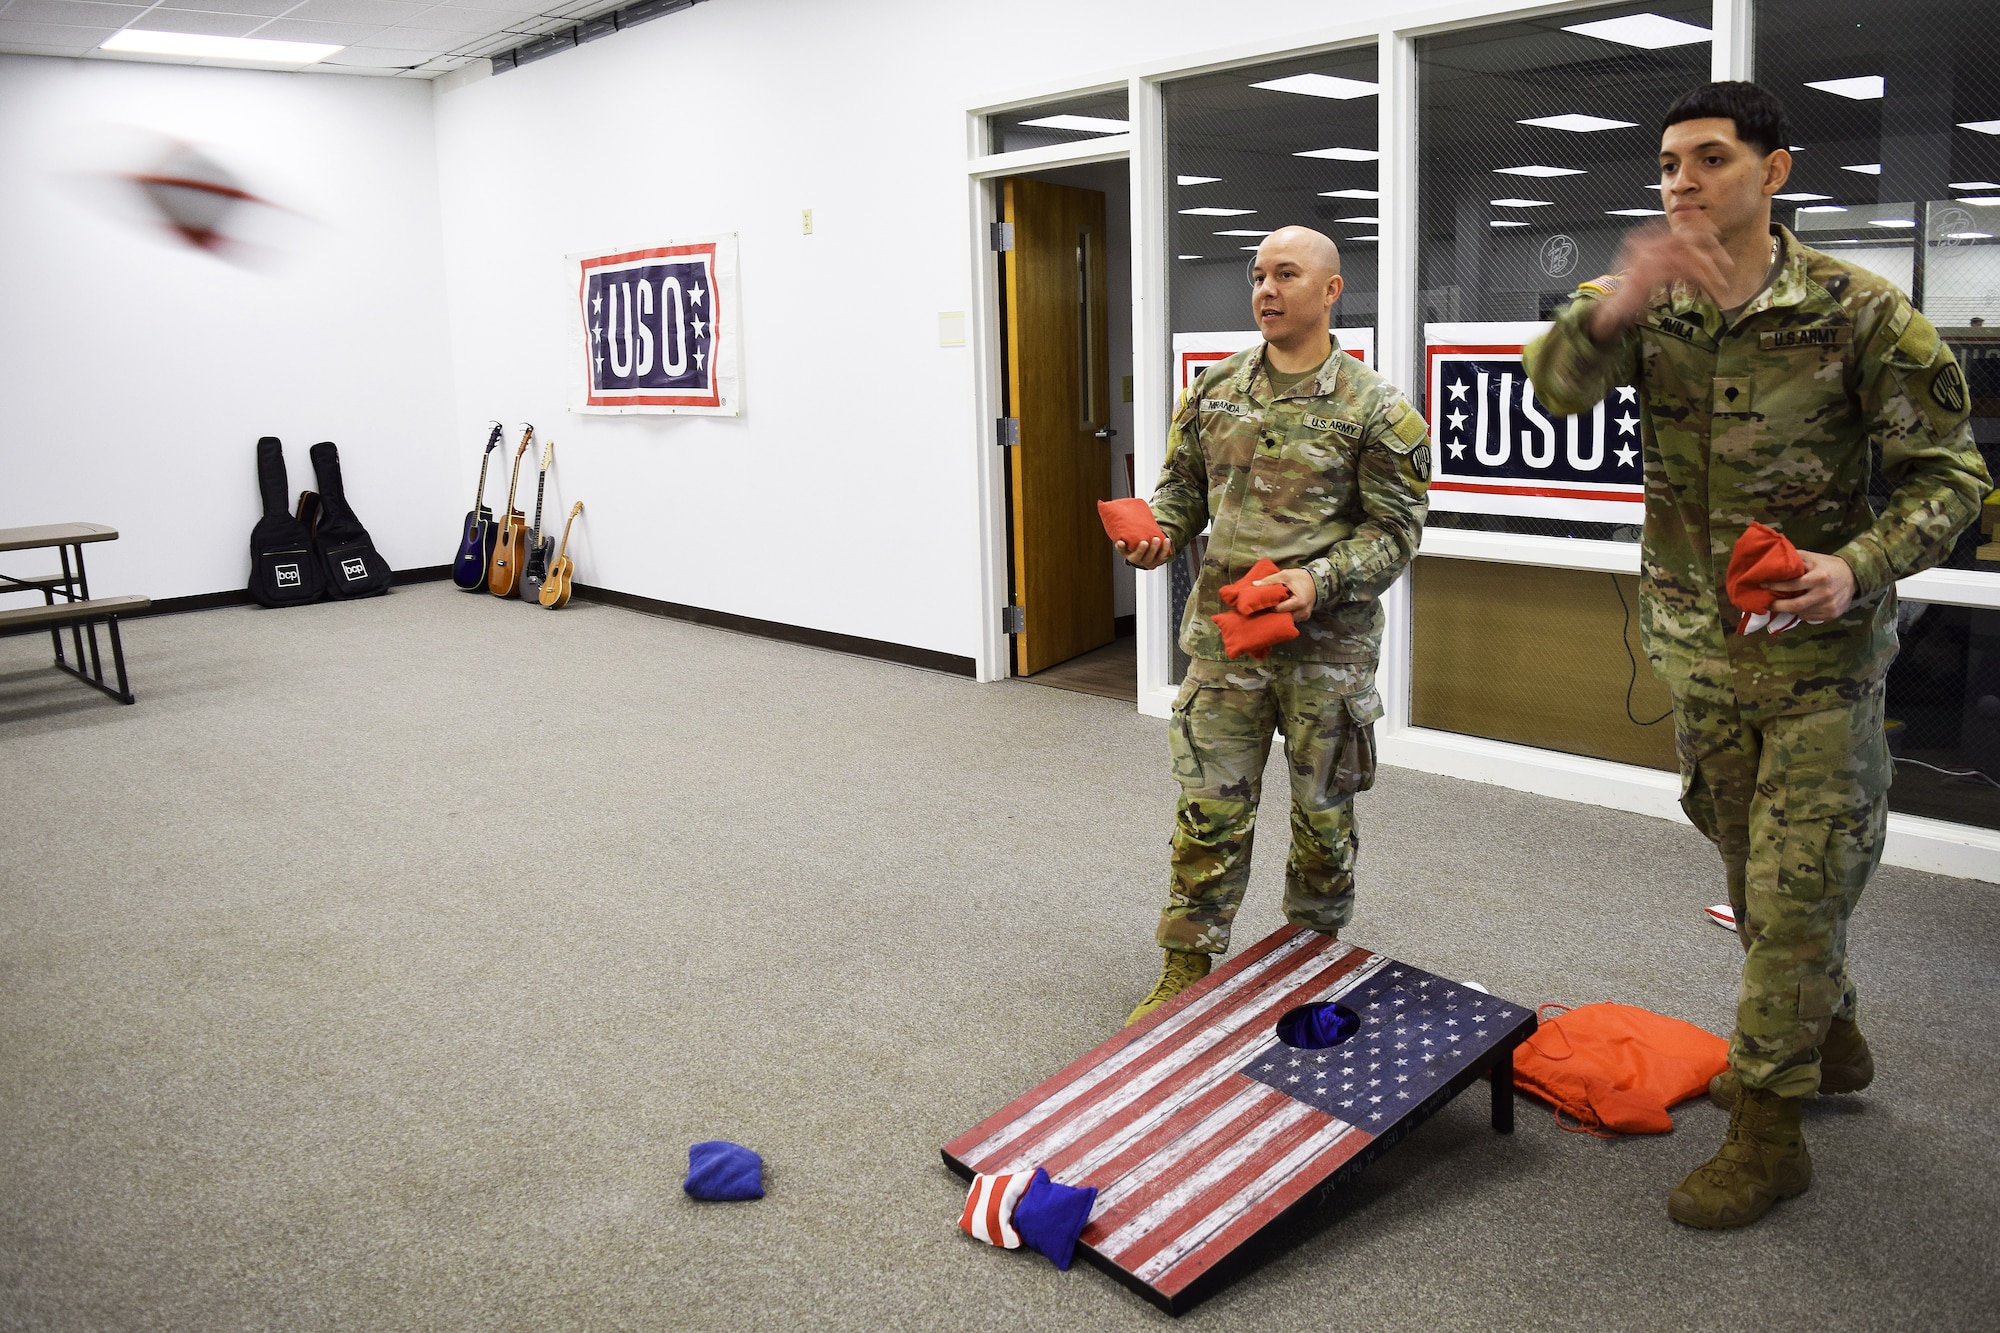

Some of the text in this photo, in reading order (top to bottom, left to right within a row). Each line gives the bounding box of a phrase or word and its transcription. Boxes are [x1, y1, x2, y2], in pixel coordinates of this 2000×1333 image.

[608, 277, 688, 378] USO
[1659, 317, 1694, 340] AVILA
[1774, 328, 1838, 346] U.S. ARMY
[1311, 418, 1357, 436] U.S. ARMY
[1475, 372, 1605, 471] USO
[279, 570, 297, 580] bcp
[344, 564, 363, 574] bcp
[1383, 1130, 1399, 1149] USO
